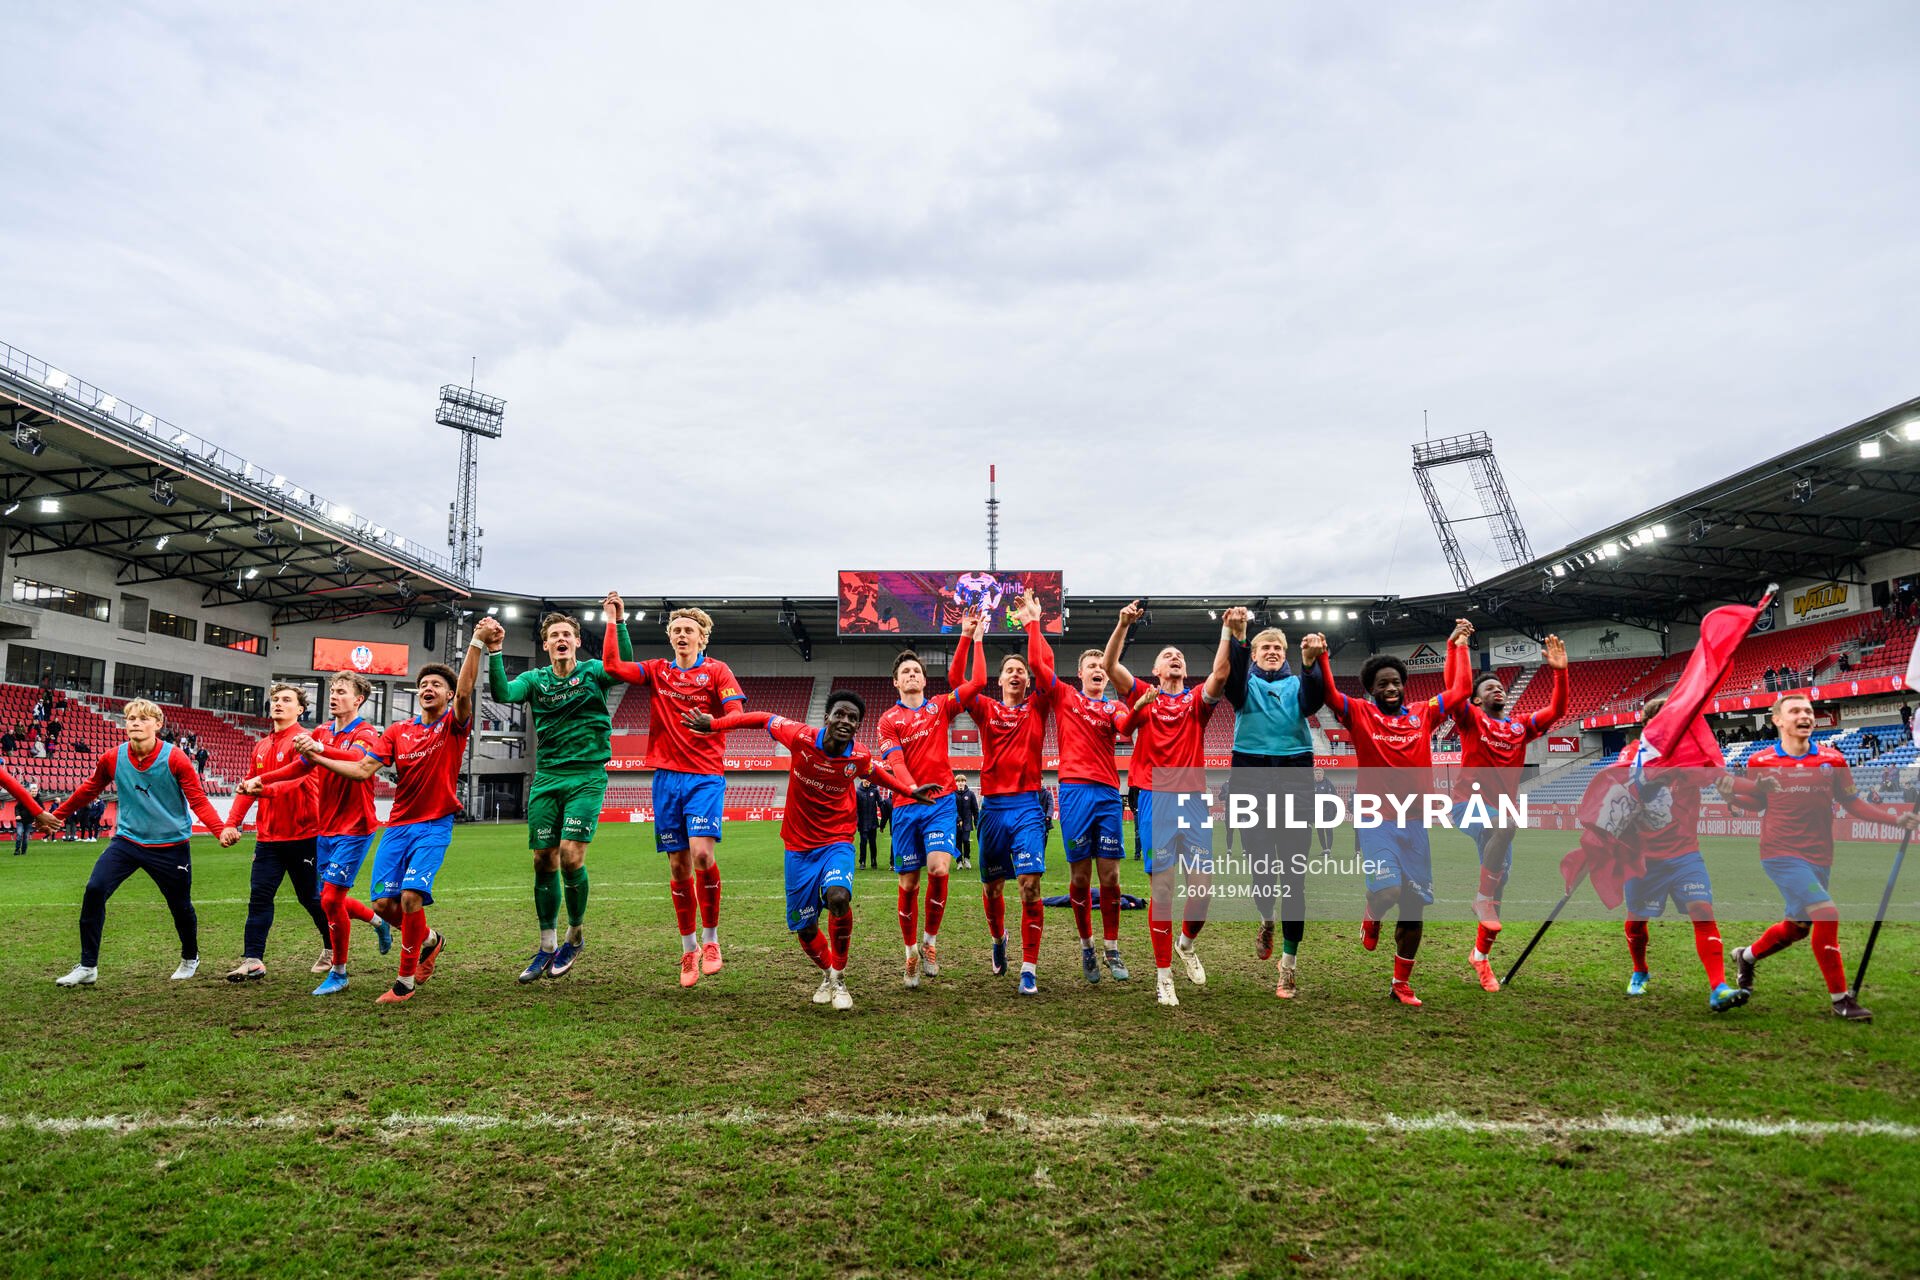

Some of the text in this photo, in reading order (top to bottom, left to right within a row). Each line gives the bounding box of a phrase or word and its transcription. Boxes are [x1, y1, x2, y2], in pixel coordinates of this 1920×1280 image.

[1793, 583, 1848, 617] WALLIN
[1505, 645, 1525, 653] EVE
[1403, 656, 1446, 666] NDERSSON
[721, 688, 738, 698] XXL
[744, 759, 772, 769] group
[566, 817, 582, 825] Fibio
[1851, 822, 1879, 839] BOKA
[928, 832, 944, 840] Fibio
[1101, 836, 1118, 845] Fibio
[1190, 845, 1210, 855] Fibio
